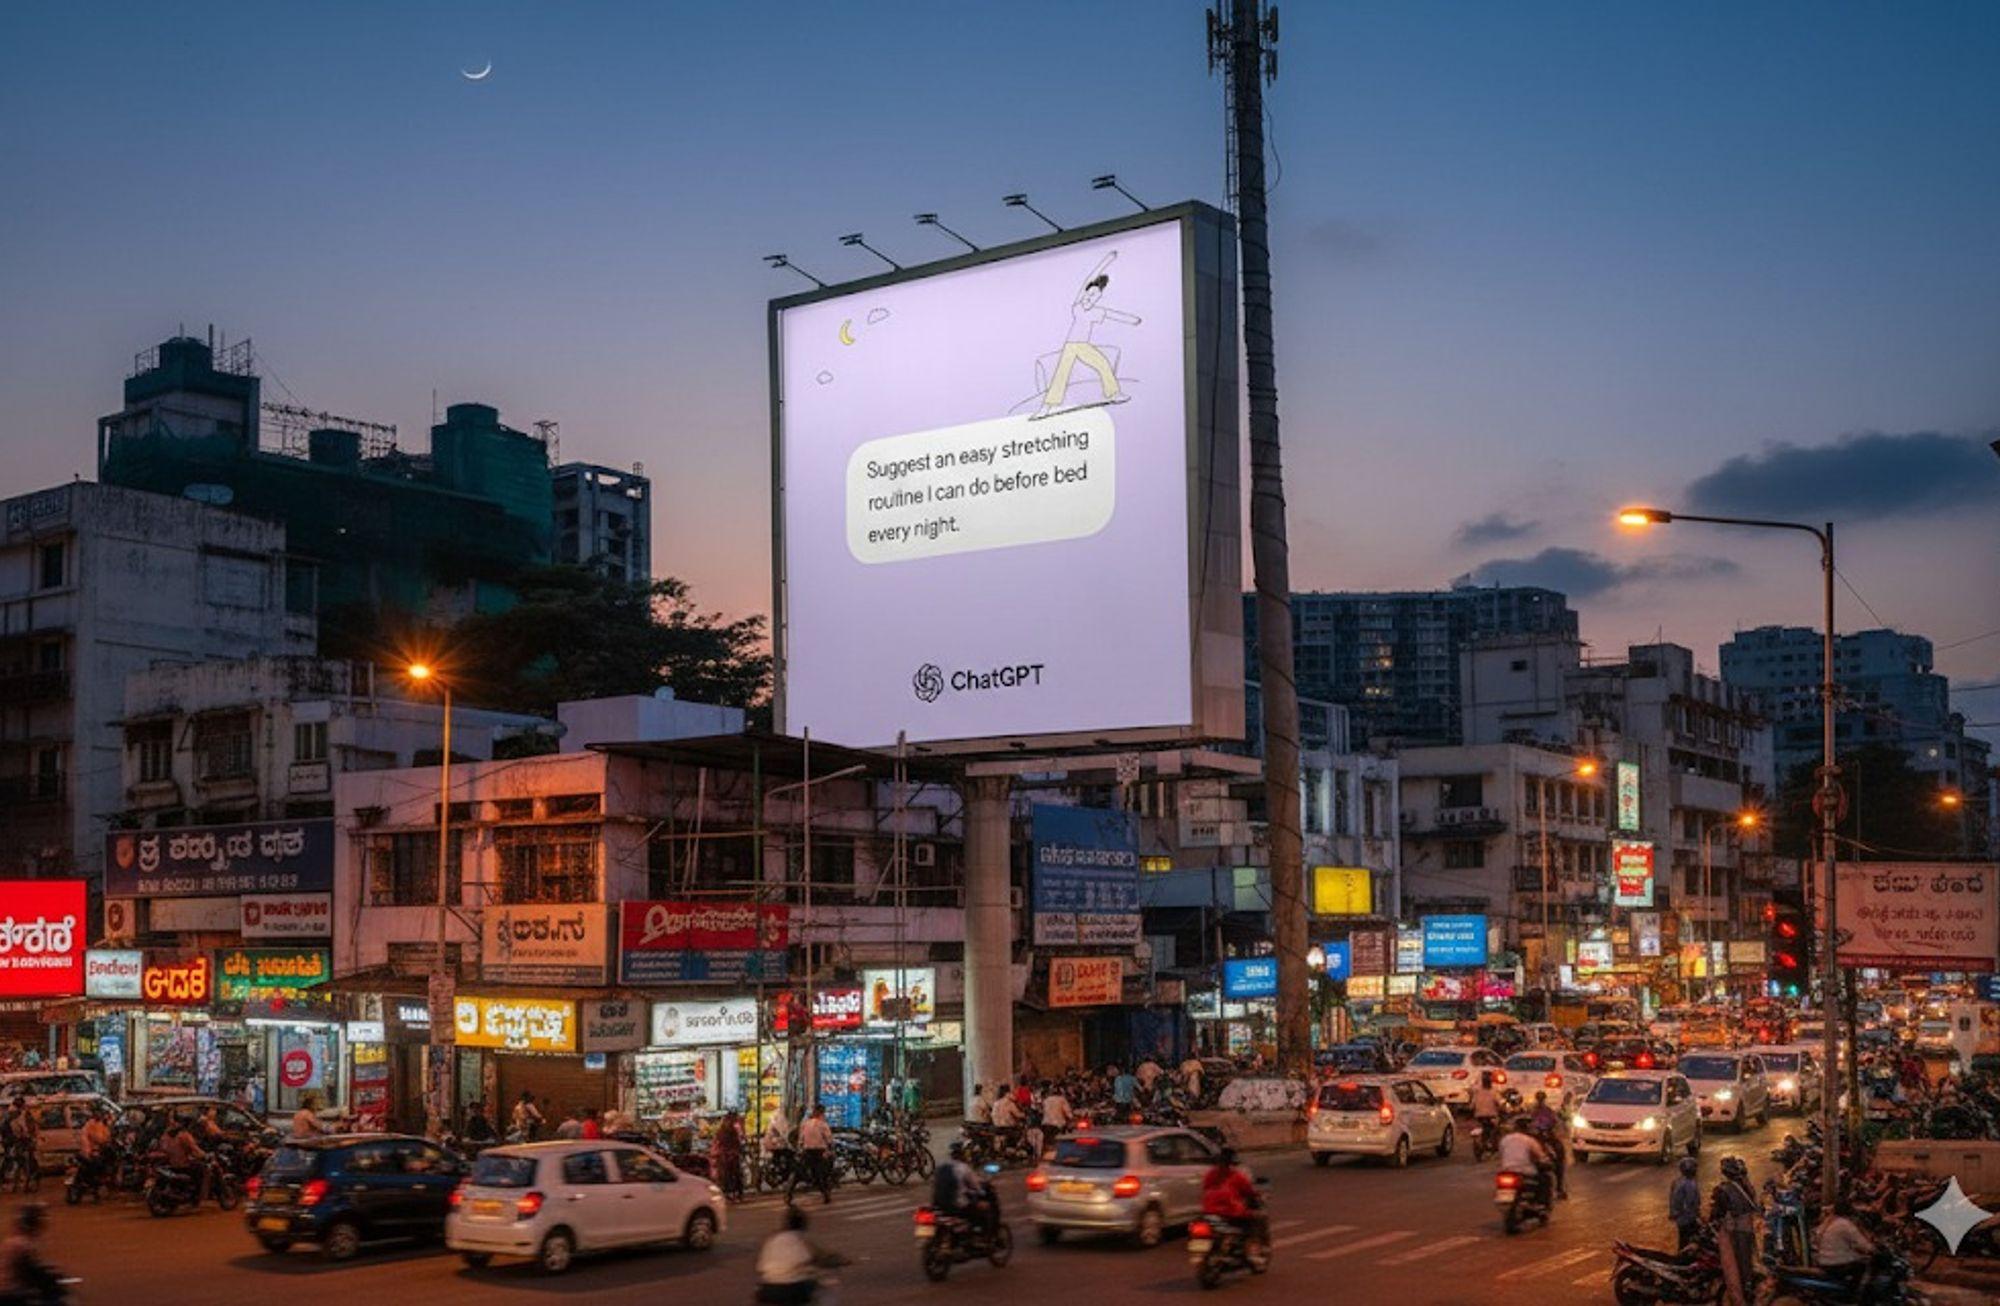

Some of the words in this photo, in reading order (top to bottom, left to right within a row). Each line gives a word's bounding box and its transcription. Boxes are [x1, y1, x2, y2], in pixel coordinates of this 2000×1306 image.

[866, 453, 931, 480] Suggest
[935, 452, 956, 468] an
[959, 446, 998, 466] easy
[1001, 430, 1090, 458] stretching
[935, 484, 965, 501] can
[969, 477, 991, 496] do
[994, 471, 1049, 493] before
[1054, 460, 1088, 484] bed
[868, 525, 912, 544] every
[914, 515, 960, 540] night.
[950, 664, 1045, 691] ChatGPT
